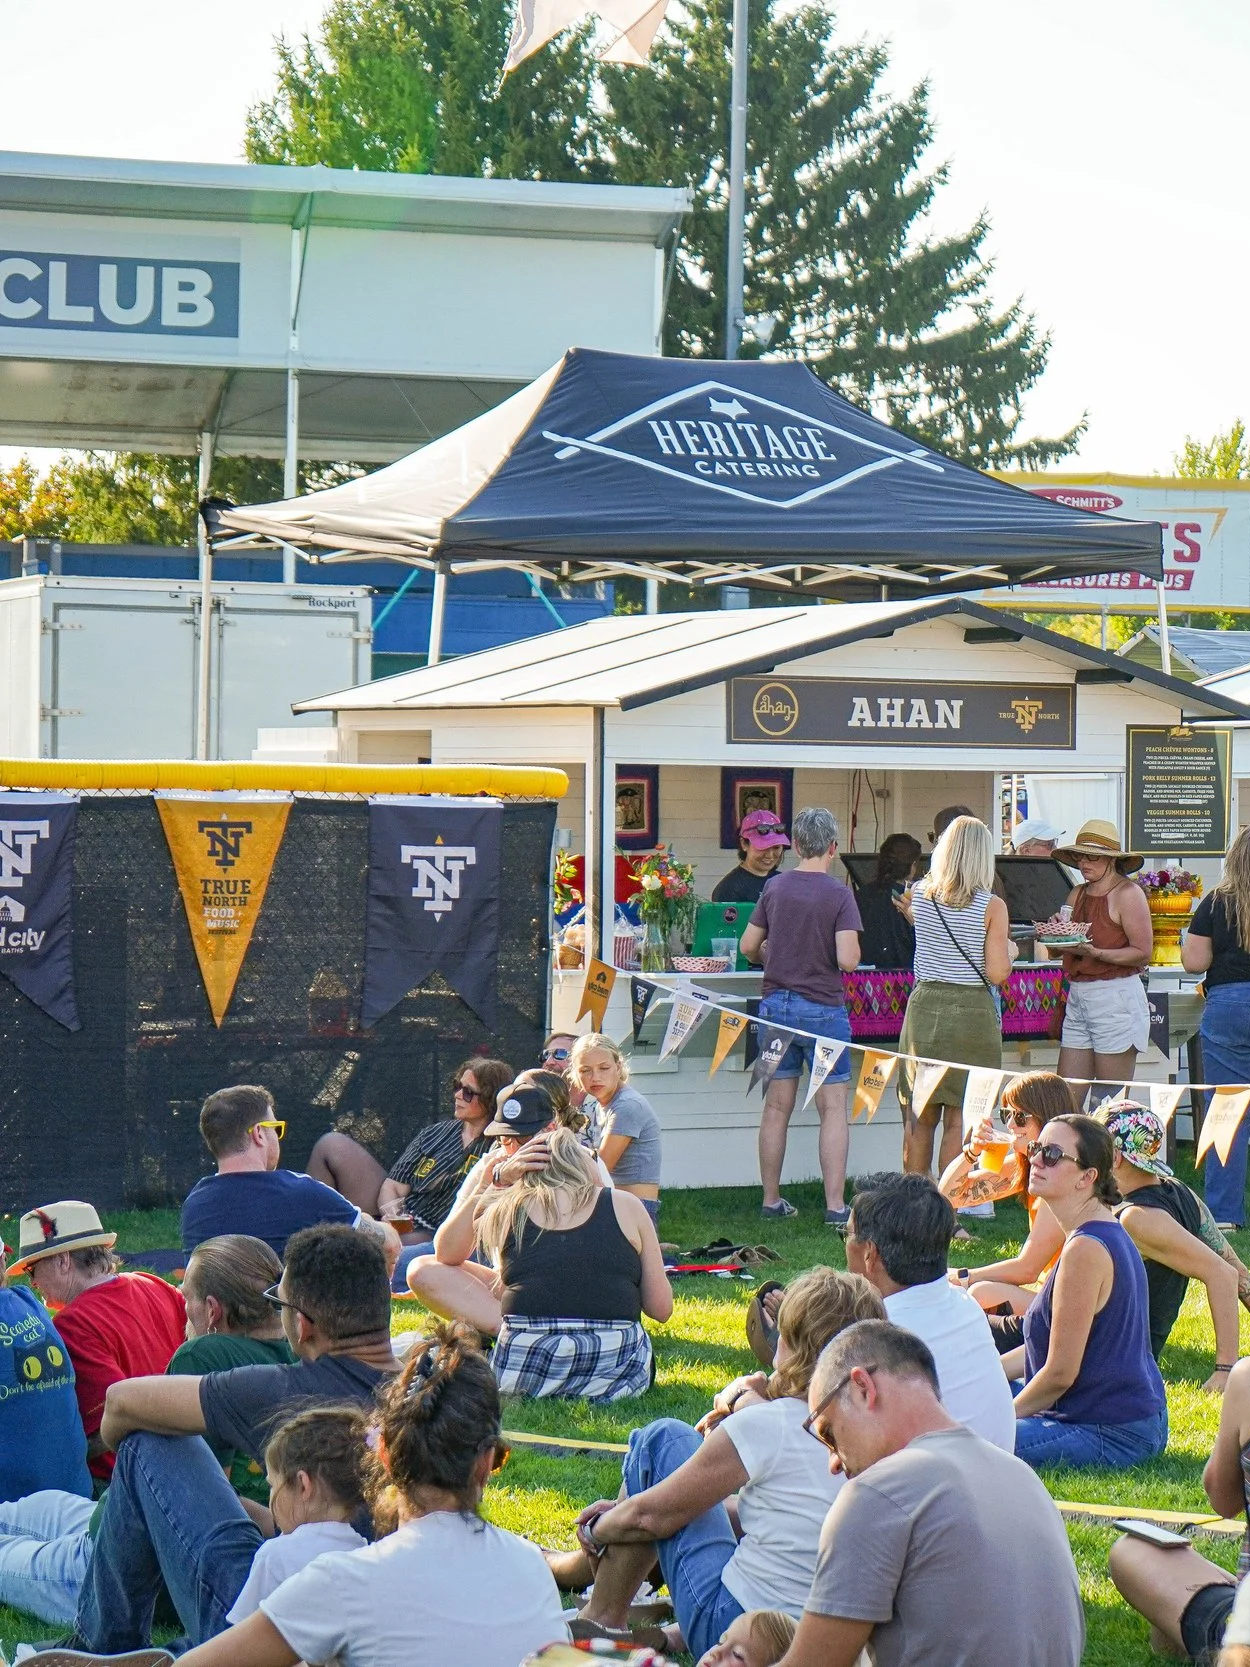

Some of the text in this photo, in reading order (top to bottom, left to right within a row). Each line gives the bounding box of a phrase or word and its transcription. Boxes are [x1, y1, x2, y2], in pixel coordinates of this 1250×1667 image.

[0, 257, 215, 328] CLUB
[648, 420, 837, 461] HERITAGE
[695, 460, 821, 478] CATERING
[1139, 572, 1186, 587] PUS
[308, 597, 357, 609] Rockport
[847, 697, 964, 729] AHAN
[200, 879, 252, 895] TRUE
[202, 896, 248, 907] NORTH
[203, 907, 235, 918] FOOD
[206, 918, 240, 928] MUSIC
[8, 928, 46, 951] city
[1151, 1014, 1164, 1024] city
[24, 1328, 41, 1343] cat
